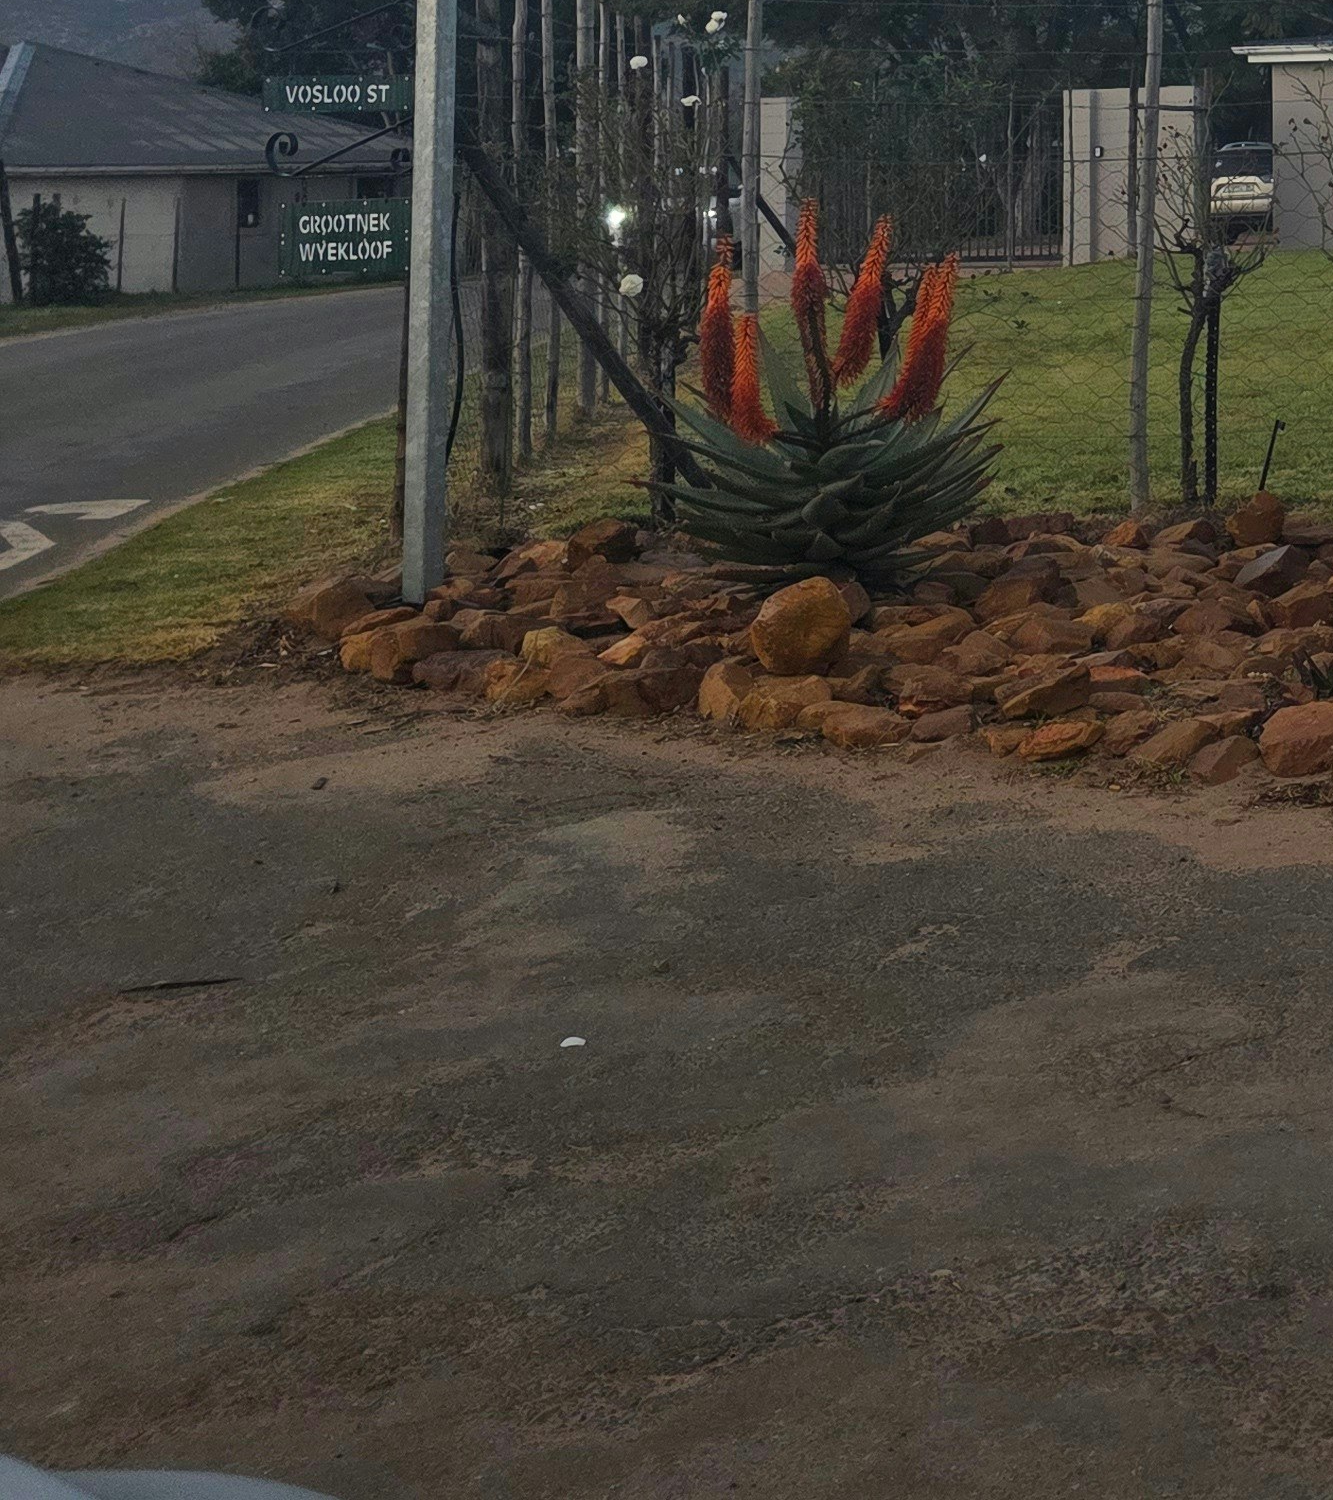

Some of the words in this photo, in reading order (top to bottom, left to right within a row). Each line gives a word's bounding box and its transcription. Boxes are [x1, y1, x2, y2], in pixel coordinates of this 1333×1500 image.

[286, 85, 360, 103] VOSLOO
[367, 85, 390, 103] ST
[299, 213, 390, 234] GROOTNEK
[299, 240, 392, 261] WYEKLOOF
